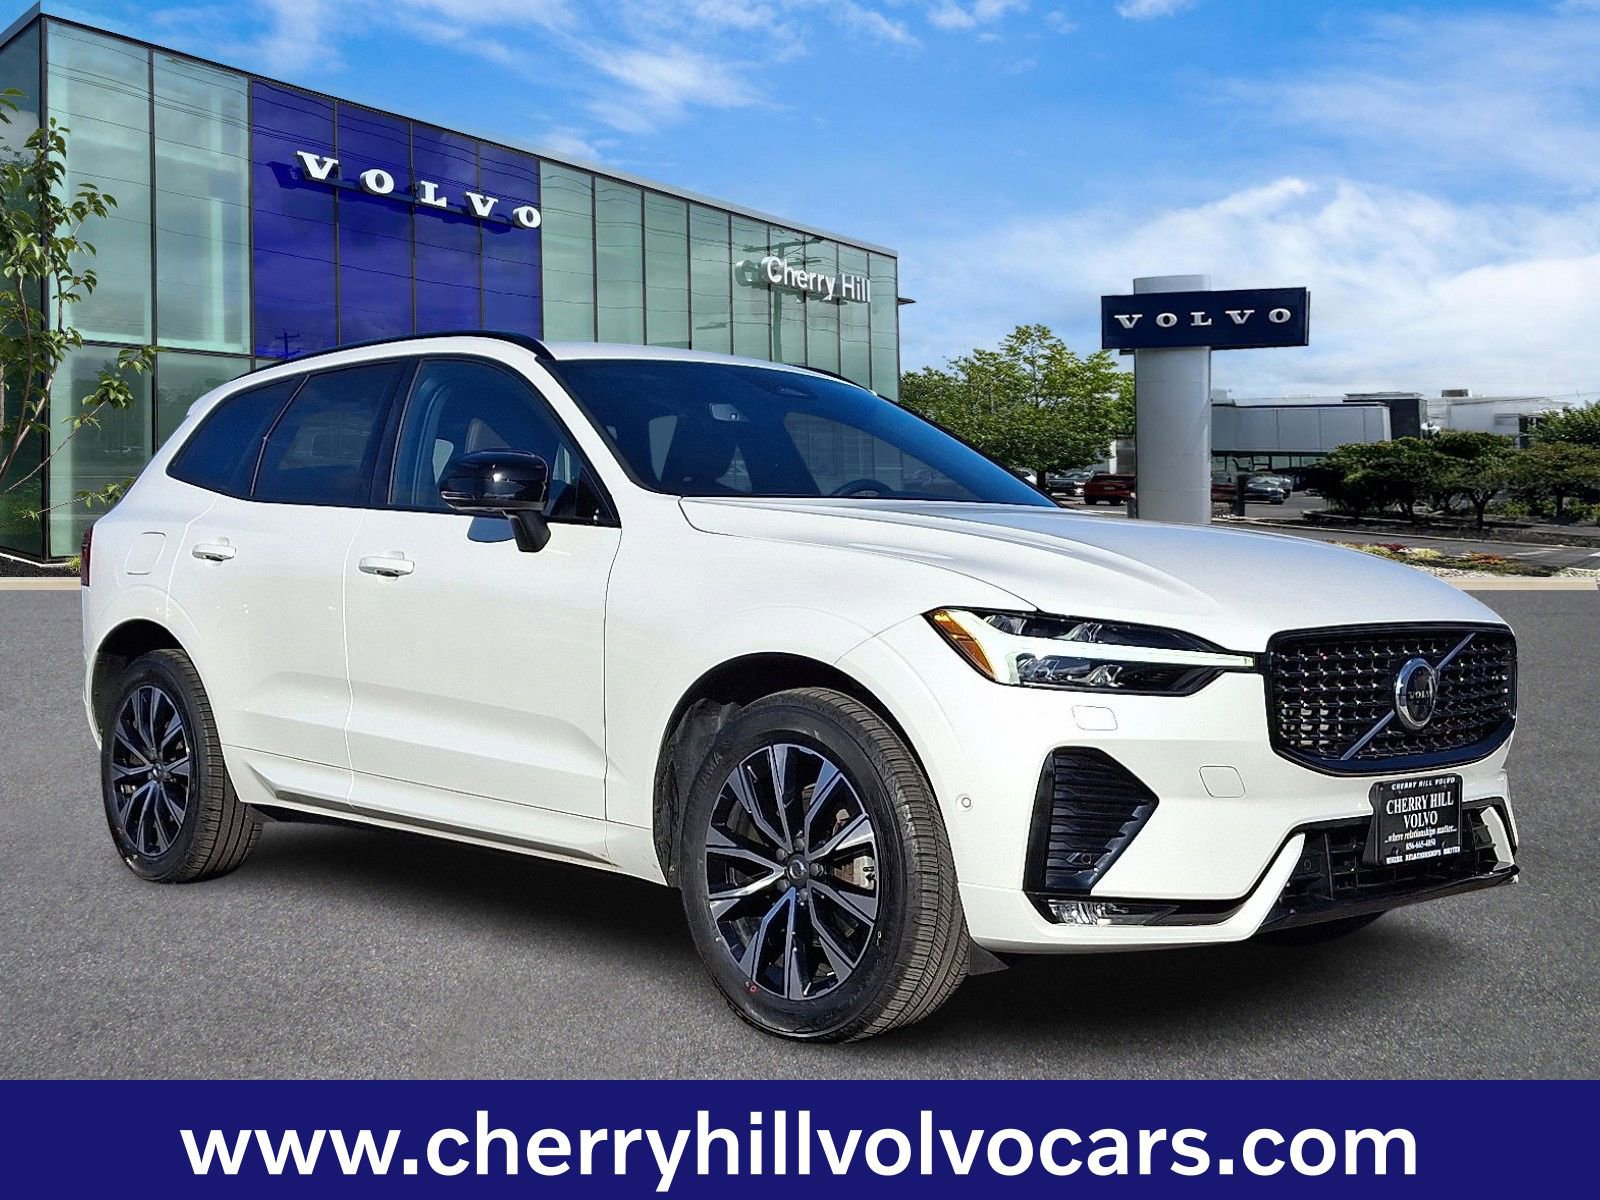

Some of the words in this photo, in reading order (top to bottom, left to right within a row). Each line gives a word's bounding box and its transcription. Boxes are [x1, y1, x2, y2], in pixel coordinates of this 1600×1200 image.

[296, 150, 542, 229] VOLVO
[763, 256, 835, 301] Cherry
[840, 273, 871, 303] Hill
[1114, 307, 1292, 329] VOLVO
[1391, 781, 1417, 791] CHERRY
[1435, 777, 1455, 785] VOLVO
[1386, 795, 1428, 815] CHERRY
[1430, 791, 1454, 809] HILL
[1403, 811, 1438, 829] VOLVO
